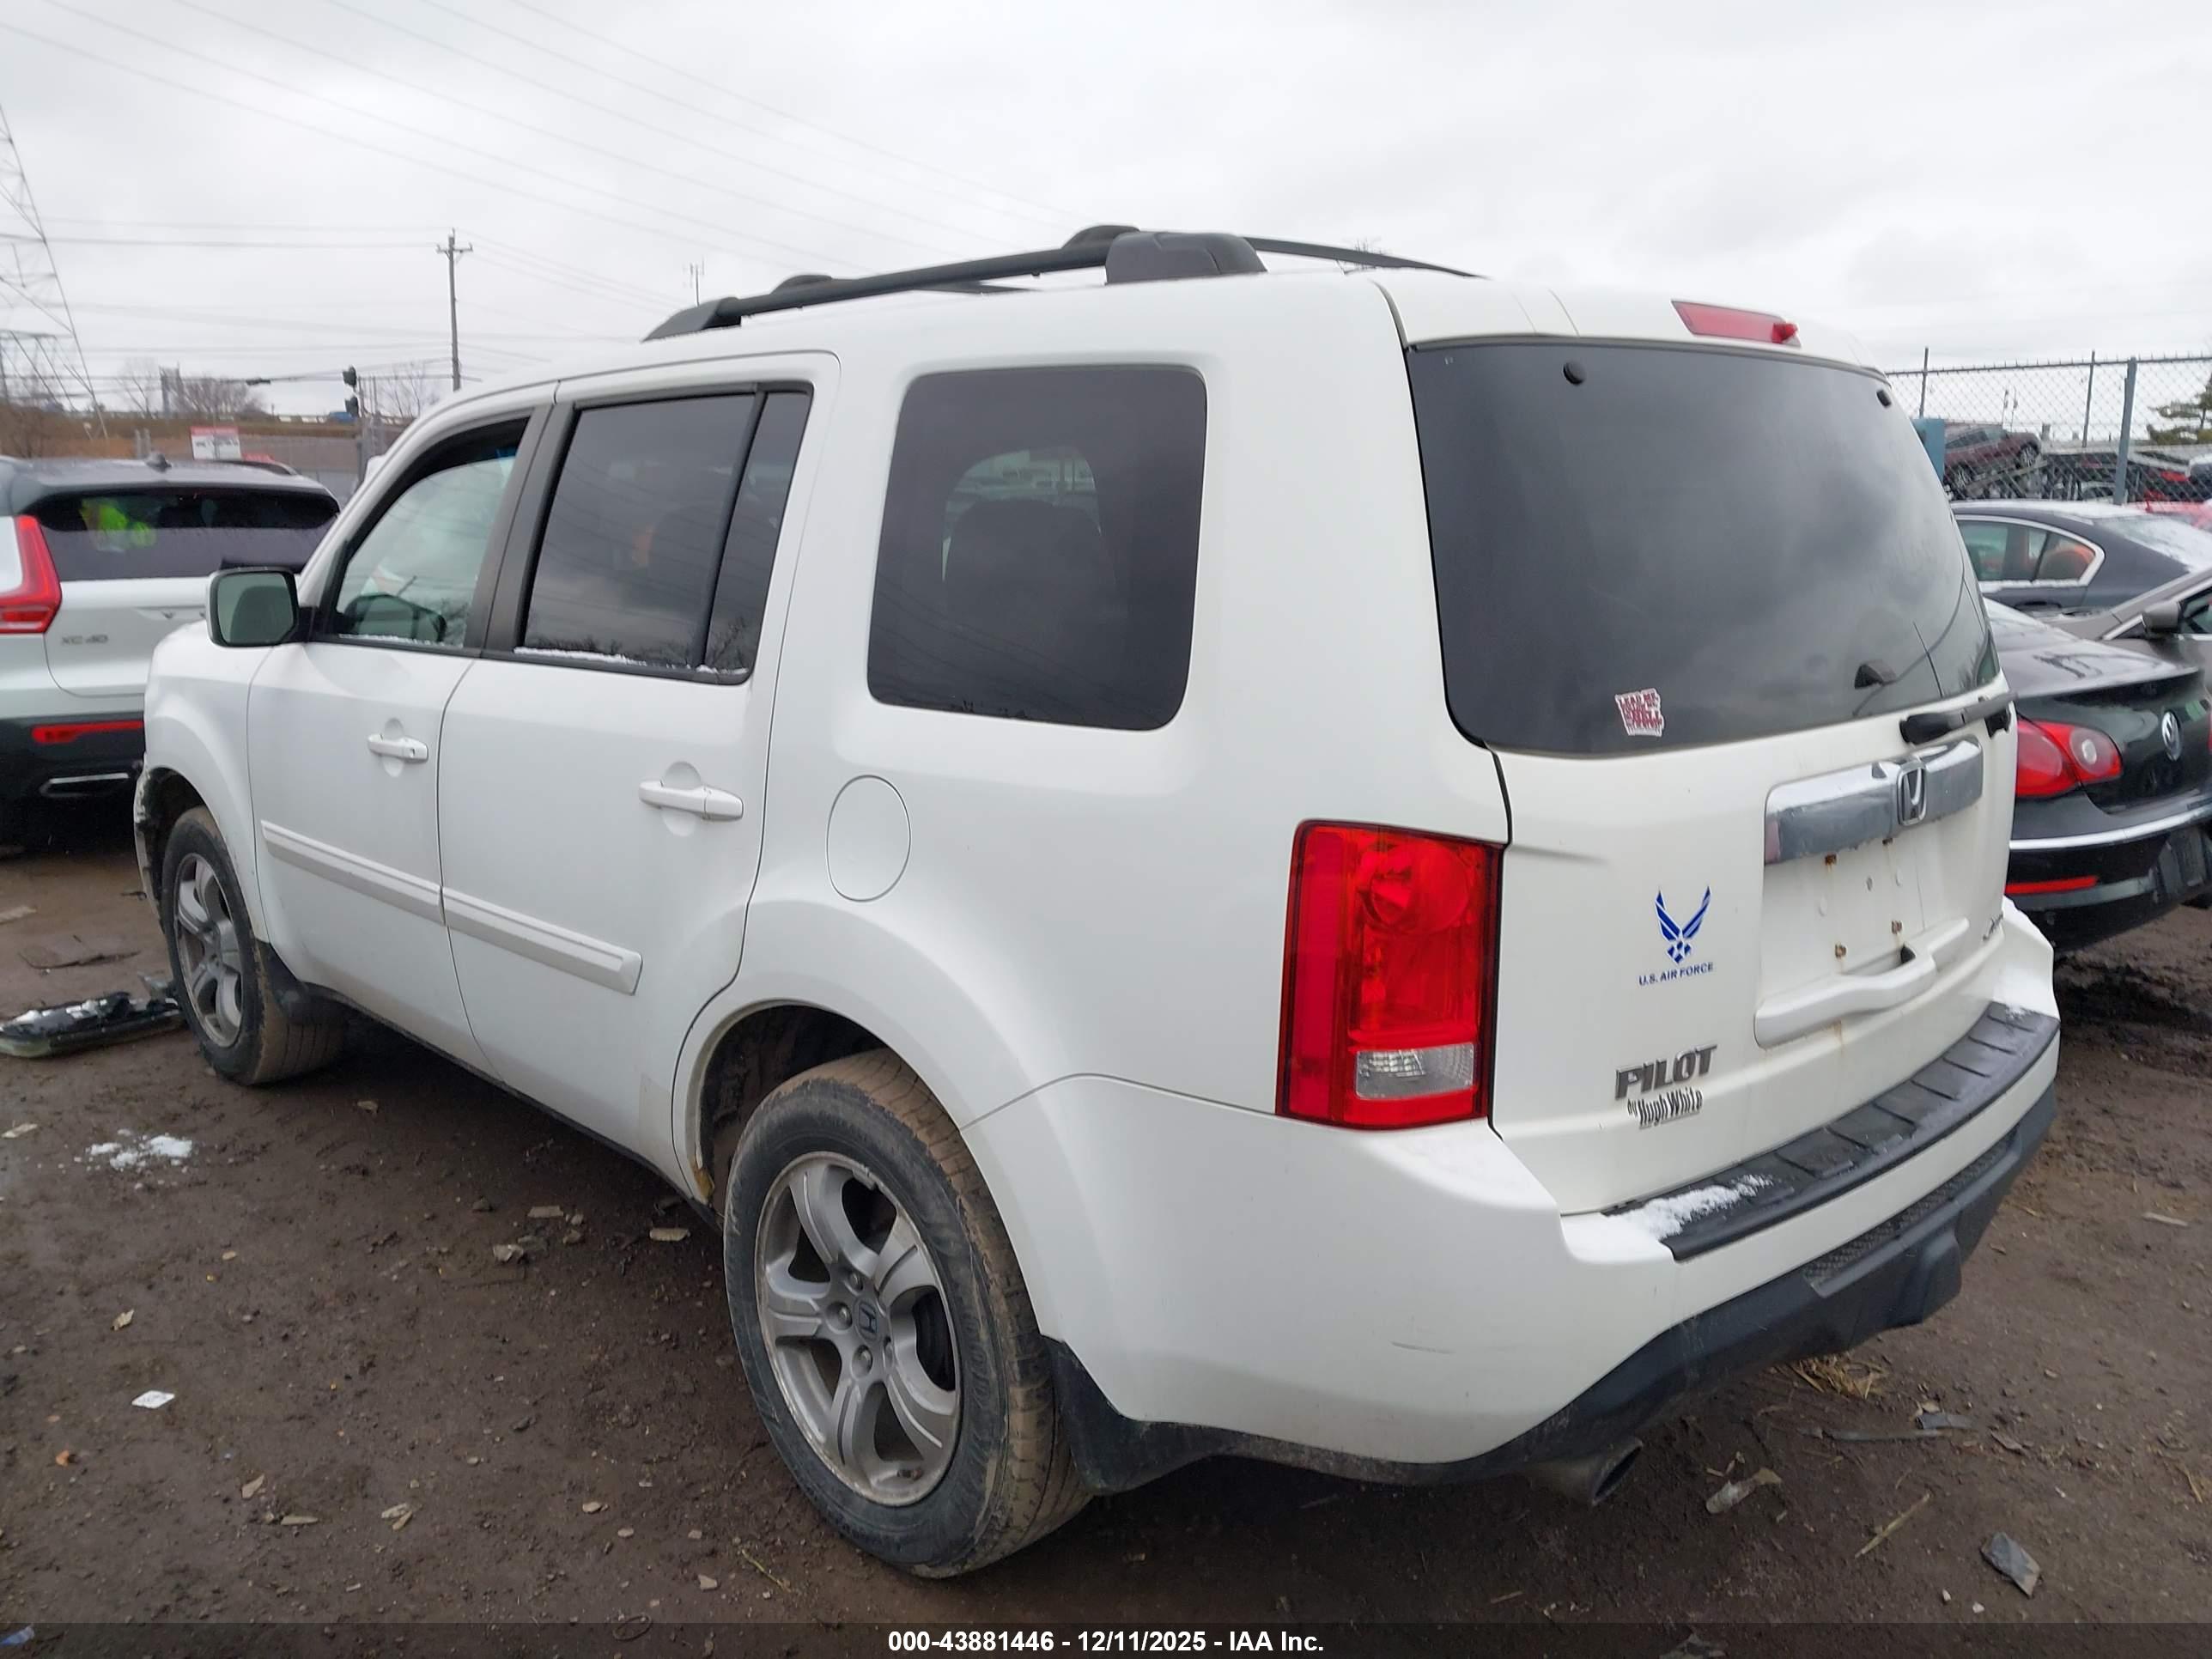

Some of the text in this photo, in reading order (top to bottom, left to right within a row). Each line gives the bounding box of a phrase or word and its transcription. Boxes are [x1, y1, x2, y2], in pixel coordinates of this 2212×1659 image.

[1638, 961, 1713, 986] U.S. AIR FORCE
[1615, 1044, 1717, 1100] PILOT
